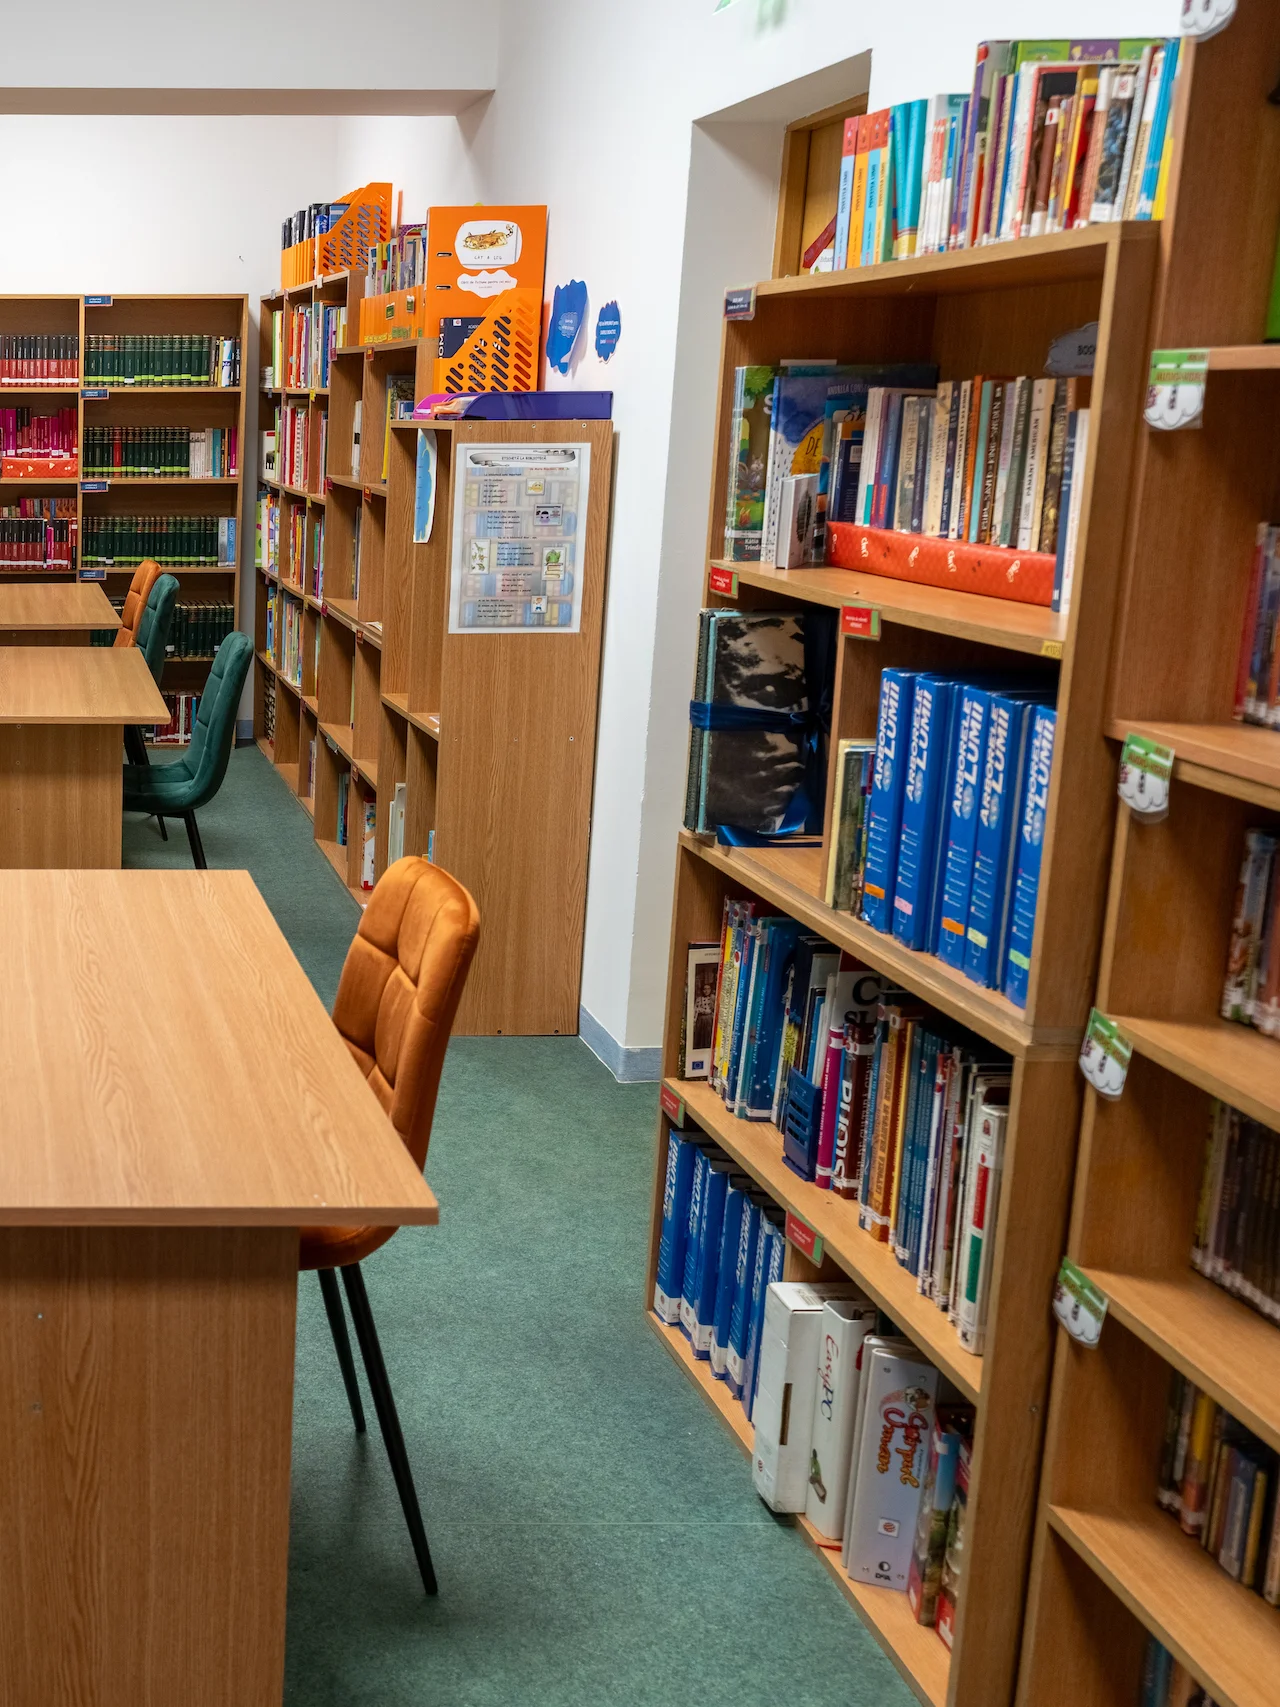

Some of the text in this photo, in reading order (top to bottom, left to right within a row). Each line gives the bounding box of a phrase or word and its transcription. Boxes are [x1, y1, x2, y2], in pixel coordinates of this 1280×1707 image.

[874, 677, 900, 790] ARBORELE LUMII
[906, 686, 933, 802] ARBORELE LUMII
[952, 697, 984, 818] ARBORELE LUMII
[980, 703, 1009, 827] ARBORELE LUMII
[1022, 715, 1055, 844] ARBORELE LUMII
